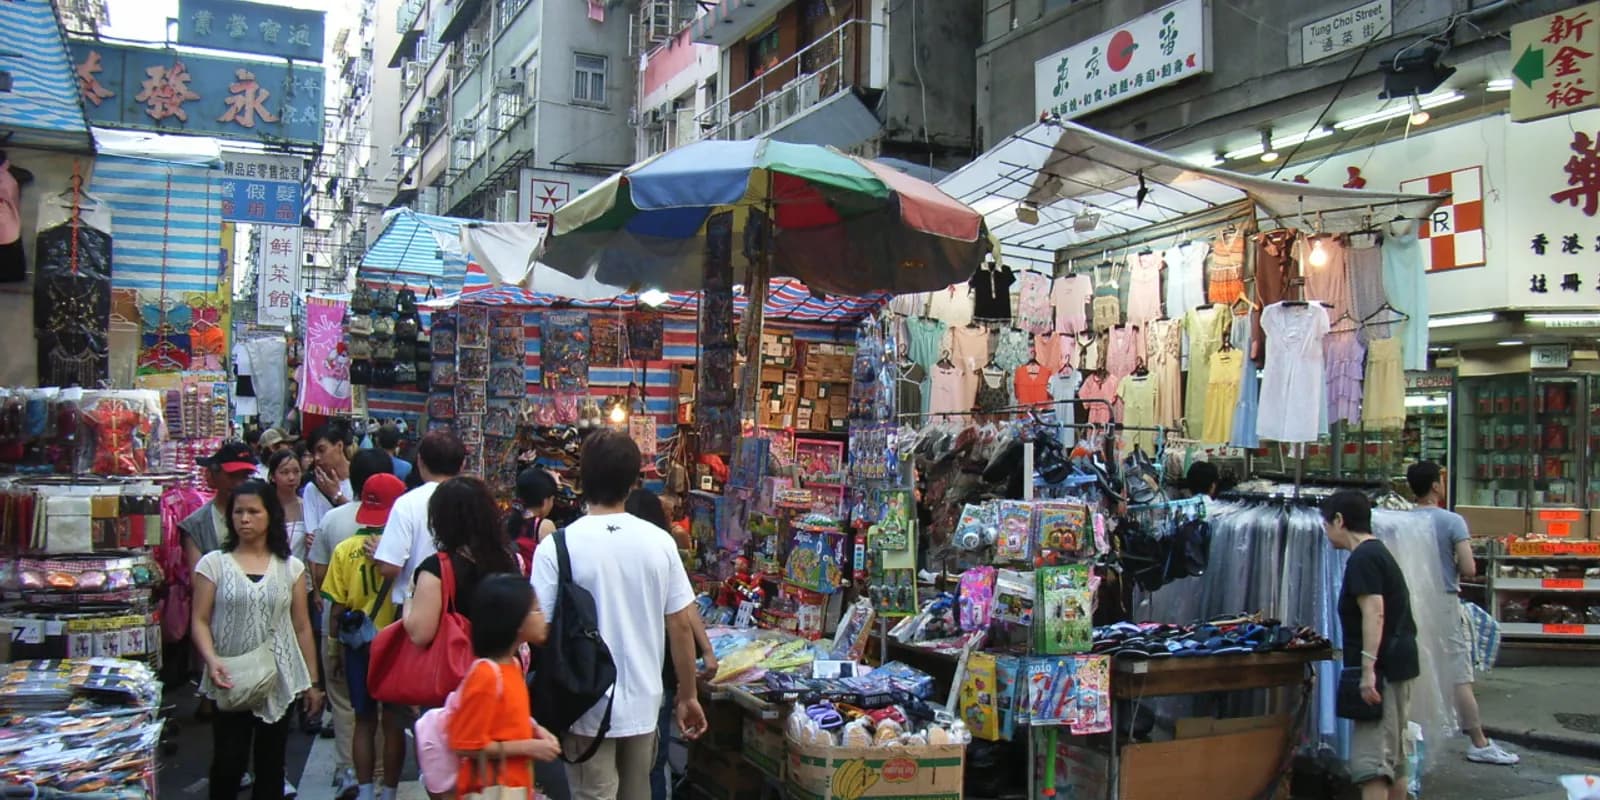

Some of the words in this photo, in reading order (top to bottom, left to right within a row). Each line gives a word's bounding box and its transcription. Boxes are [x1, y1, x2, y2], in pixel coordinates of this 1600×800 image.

[1310, 23, 1332, 37] Tung
[1333, 12, 1354, 30] Choi
[1355, 4, 1383, 22] Street
[1322, 22, 1375, 52] 通菜街
[1541, 12, 1595, 109] 新金裕
[224, 160, 300, 181] 精品店零售批發
[1531, 233, 1600, 256] 香港
[267, 225, 294, 308] 鮮菜館
[1530, 273, 1600, 293] 註冊
[1028, 659, 1052, 673] 2010
